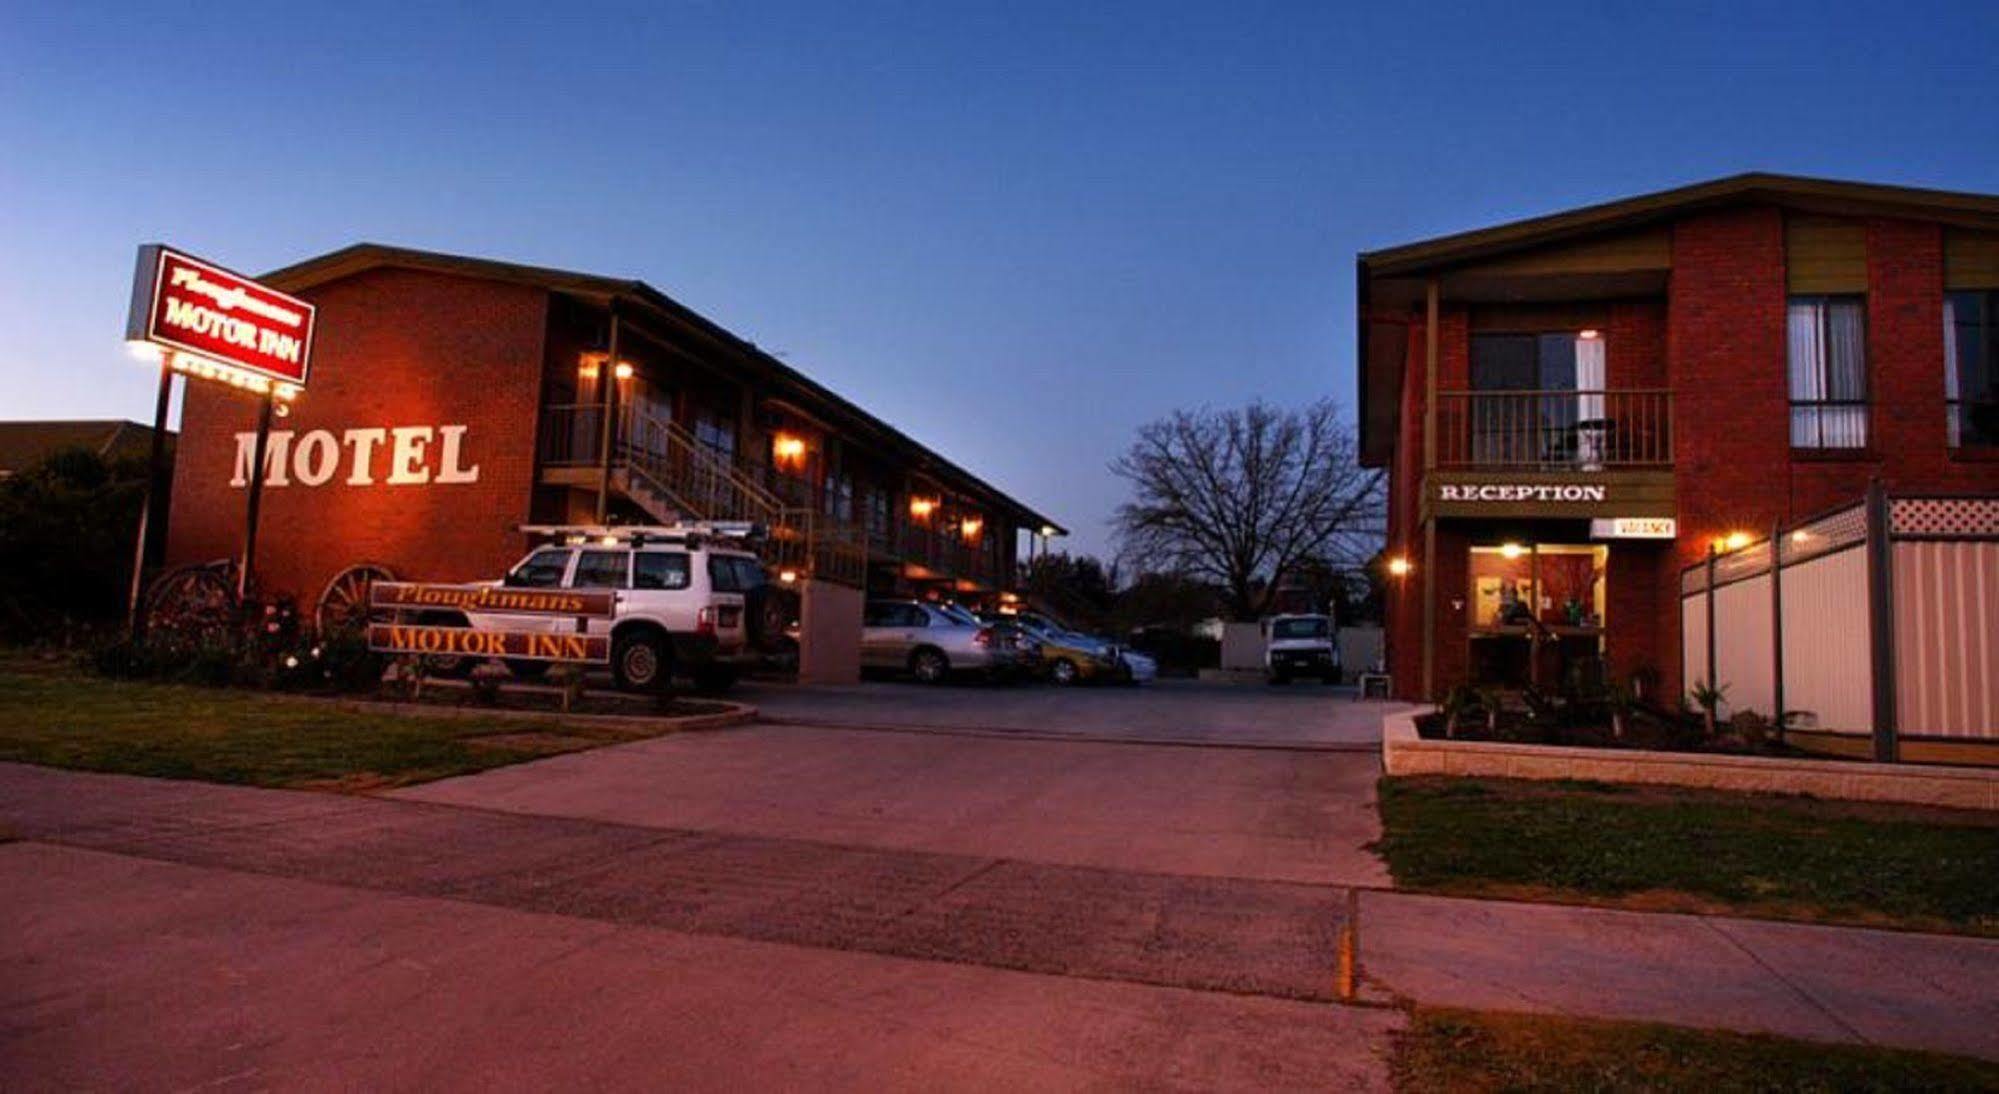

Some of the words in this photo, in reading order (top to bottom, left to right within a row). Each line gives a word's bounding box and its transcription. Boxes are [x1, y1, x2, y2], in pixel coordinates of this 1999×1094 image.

[167, 298, 256, 348] MOTOR
[260, 329, 300, 361] INN
[230, 425, 479, 487] MOTEL
[1441, 485, 1606, 500] RECEPTION
[396, 586, 584, 609] Ploughmans
[389, 625, 506, 654] MOTOR
[528, 633, 587, 657] INN
